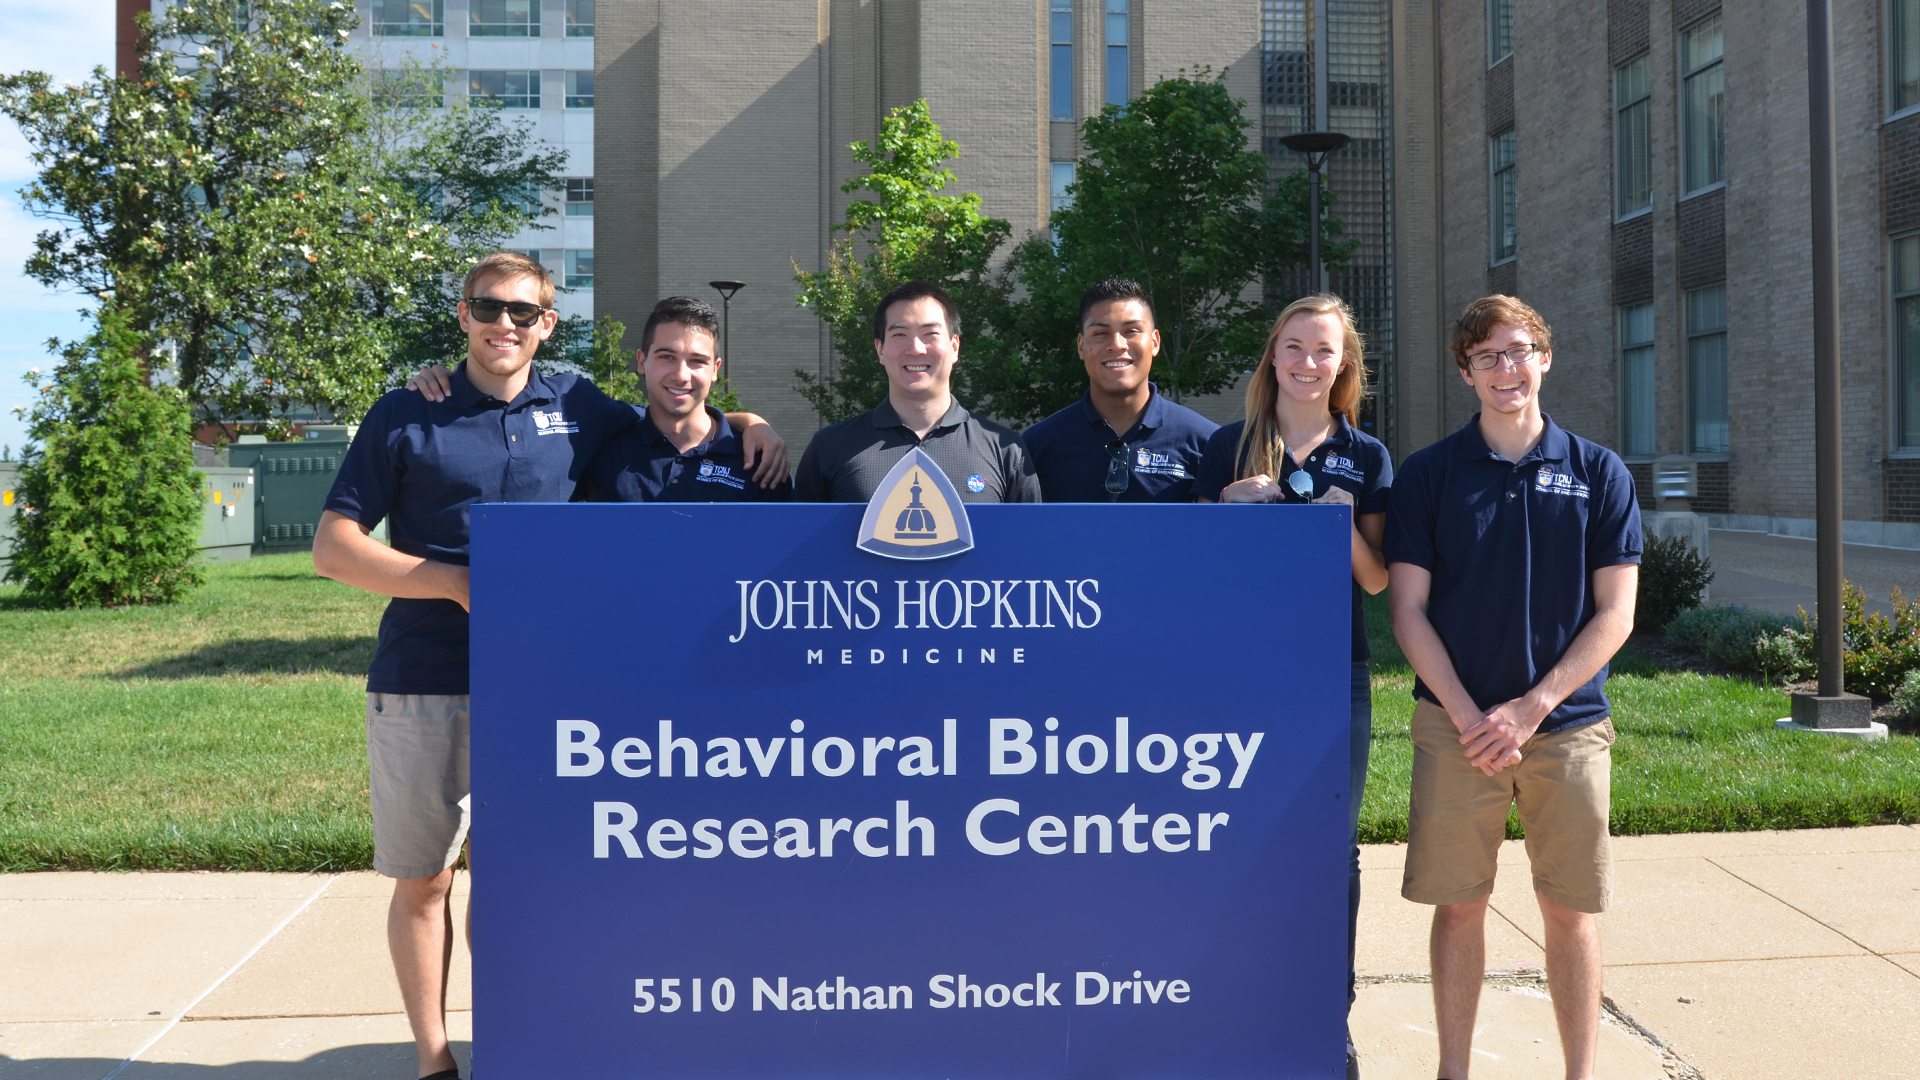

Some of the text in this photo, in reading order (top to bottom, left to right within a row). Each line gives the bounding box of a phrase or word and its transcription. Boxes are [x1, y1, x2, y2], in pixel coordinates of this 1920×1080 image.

[714, 465, 731, 475] TCNJ
[1152, 453, 1169, 463] TCNJ
[1554, 473, 1573, 485] TCNJ
[729, 578, 1102, 644] JOHNS HOPKINS
[807, 647, 1025, 665] MEDICINE
[556, 716, 1265, 791] Behavioral Biology
[593, 797, 1230, 859] Research Center
[633, 969, 1191, 1014] 5510 Nathan Shock Drive
